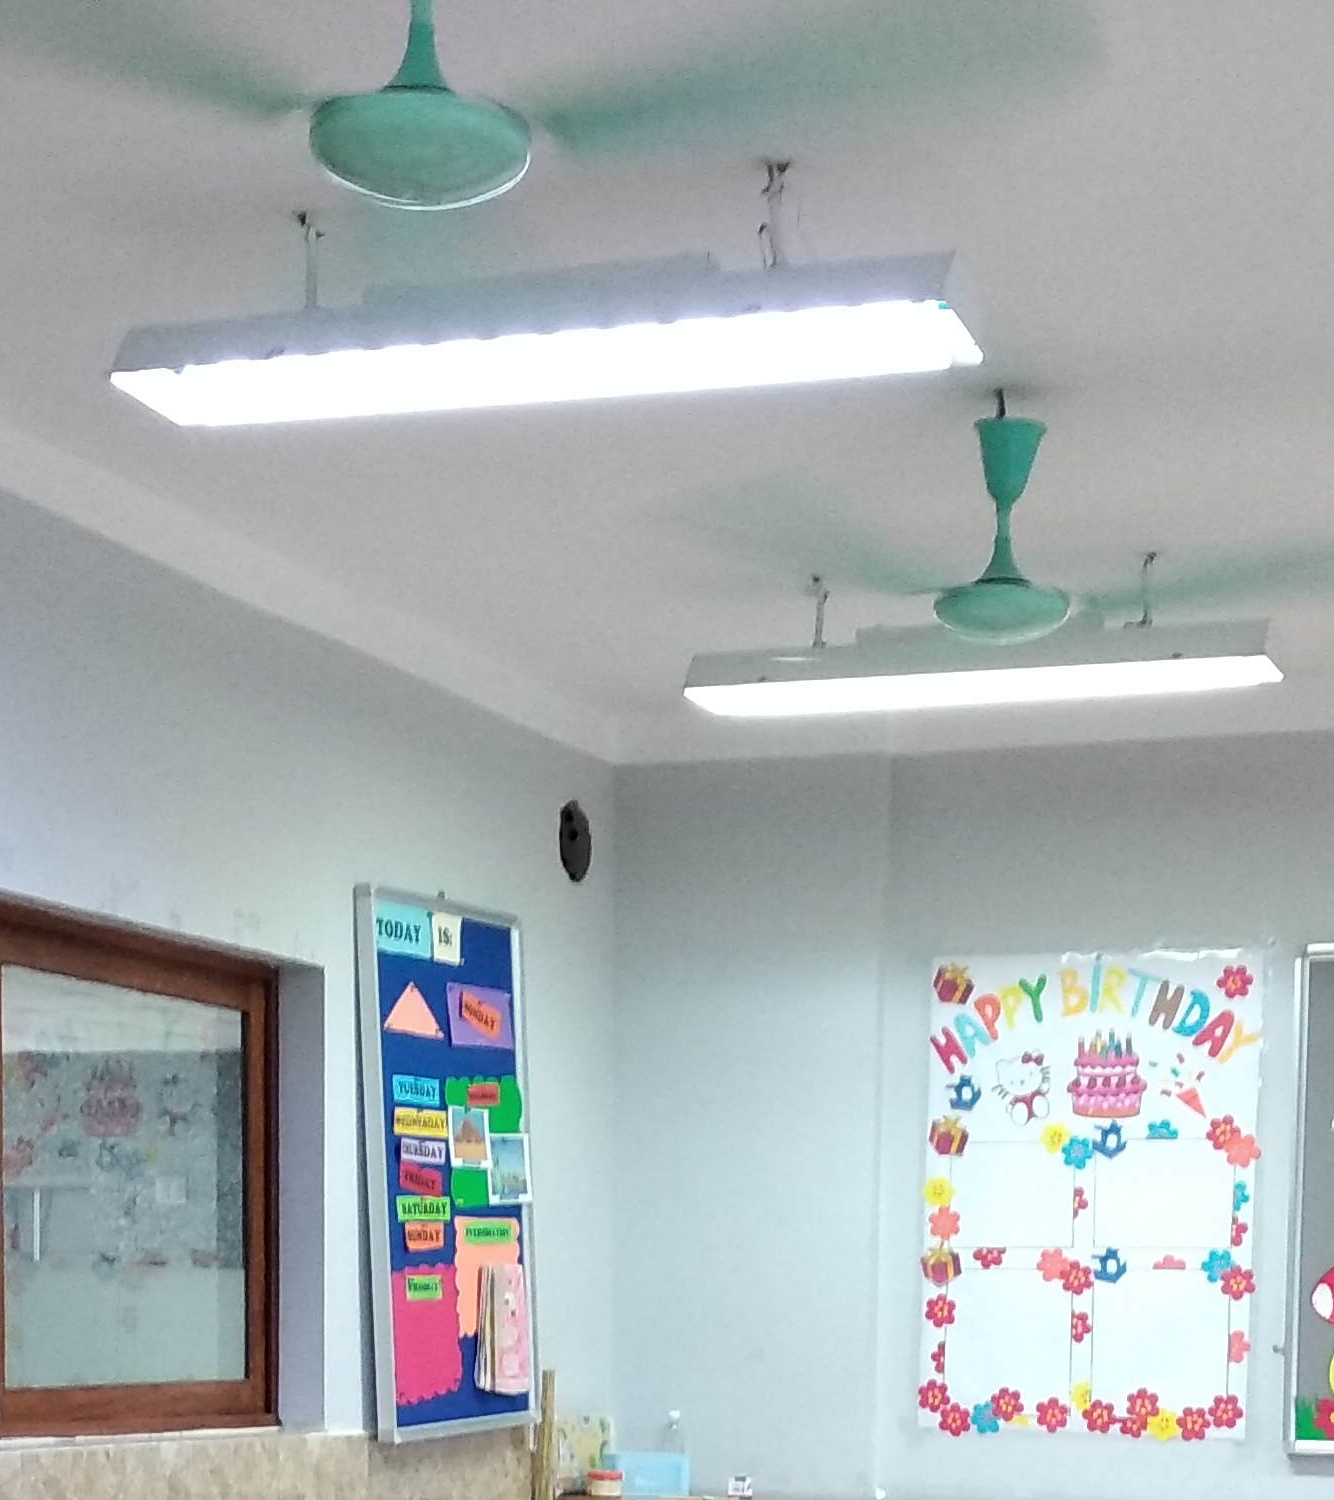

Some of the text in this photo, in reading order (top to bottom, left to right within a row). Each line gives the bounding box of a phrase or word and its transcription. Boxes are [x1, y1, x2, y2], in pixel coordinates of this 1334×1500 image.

[375, 916, 422, 943] TODAY
[930, 952, 1263, 1074] HAPPY BIRTHDAY
[397, 1081, 437, 1097] TUESDAY
[407, 1228, 441, 1242] SUNDAY
